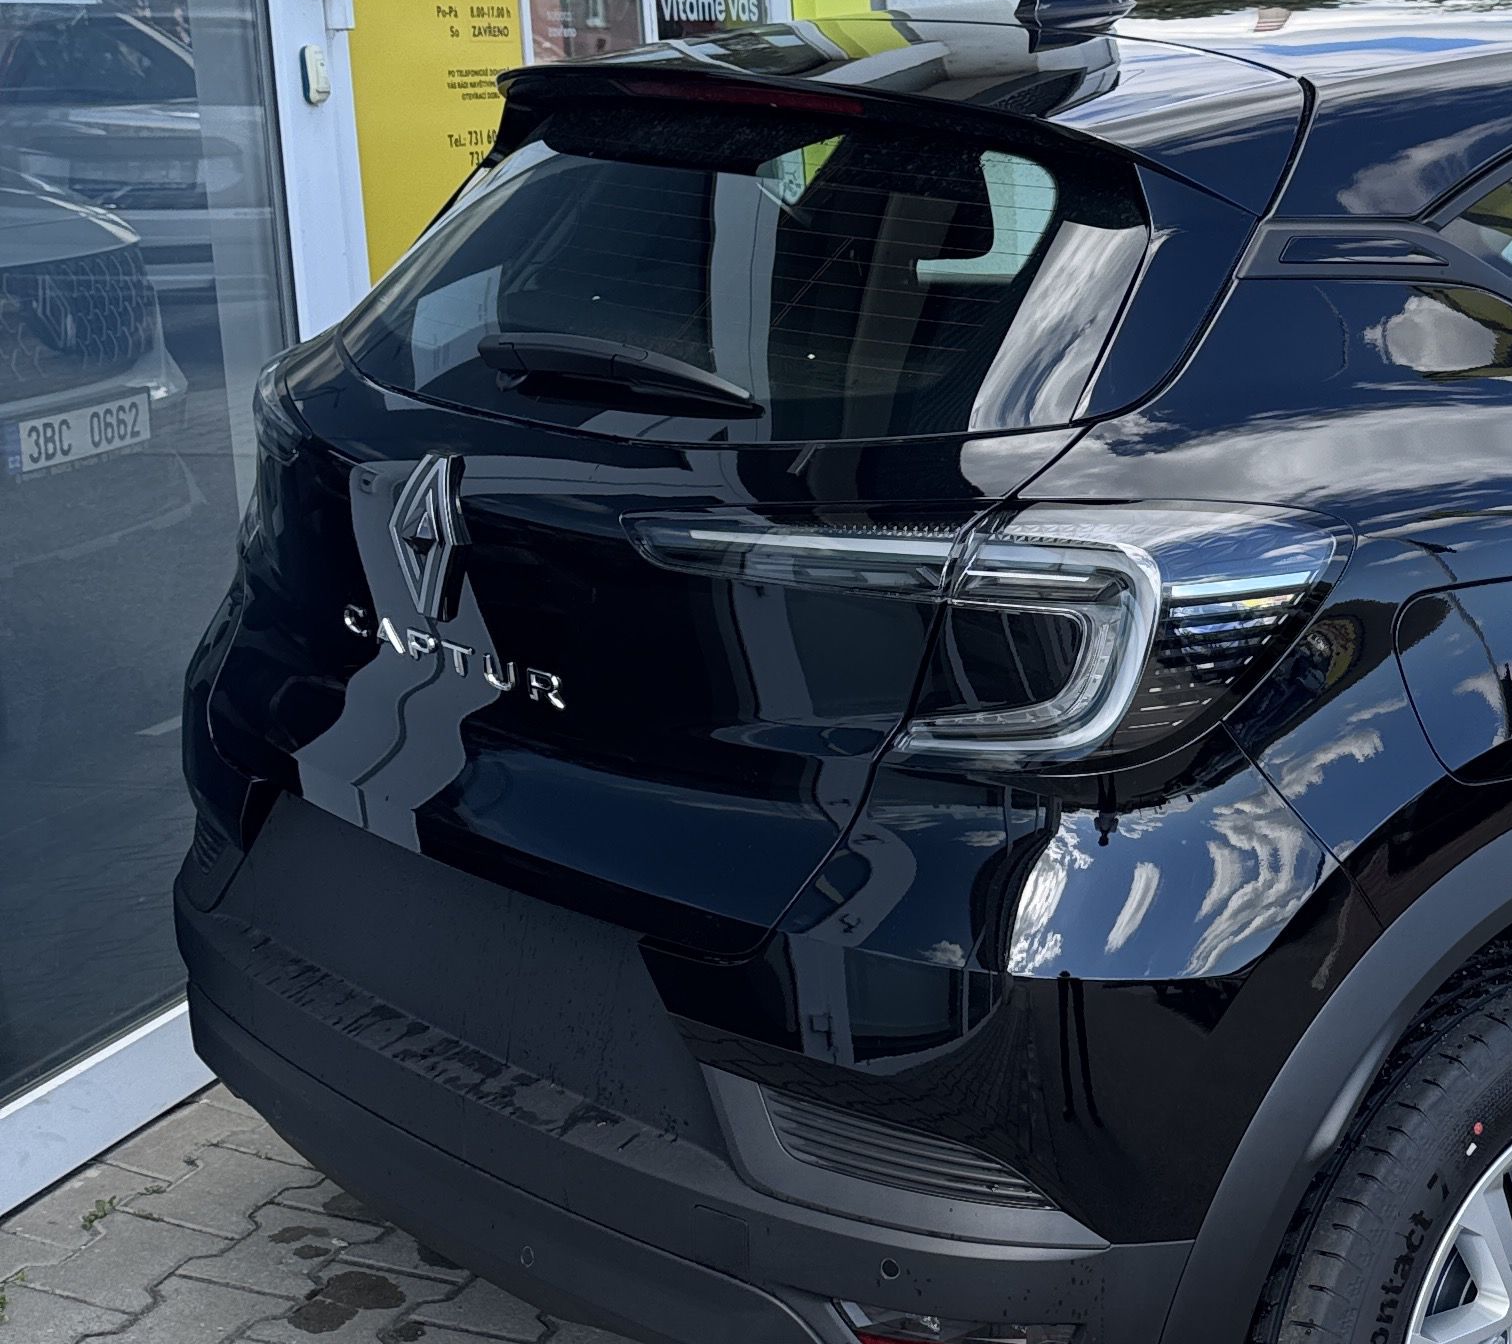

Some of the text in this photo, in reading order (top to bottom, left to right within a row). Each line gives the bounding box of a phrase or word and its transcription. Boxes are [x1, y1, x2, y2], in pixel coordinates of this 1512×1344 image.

[472, 23, 509, 37] ZAVŘENO
[468, 130, 484, 146] 731
[27, 419, 73, 464] 3BC
[89, 401, 141, 448] 0662
[343, 604, 565, 709] CAPTUR
[1427, 1172, 1450, 1201] 7
